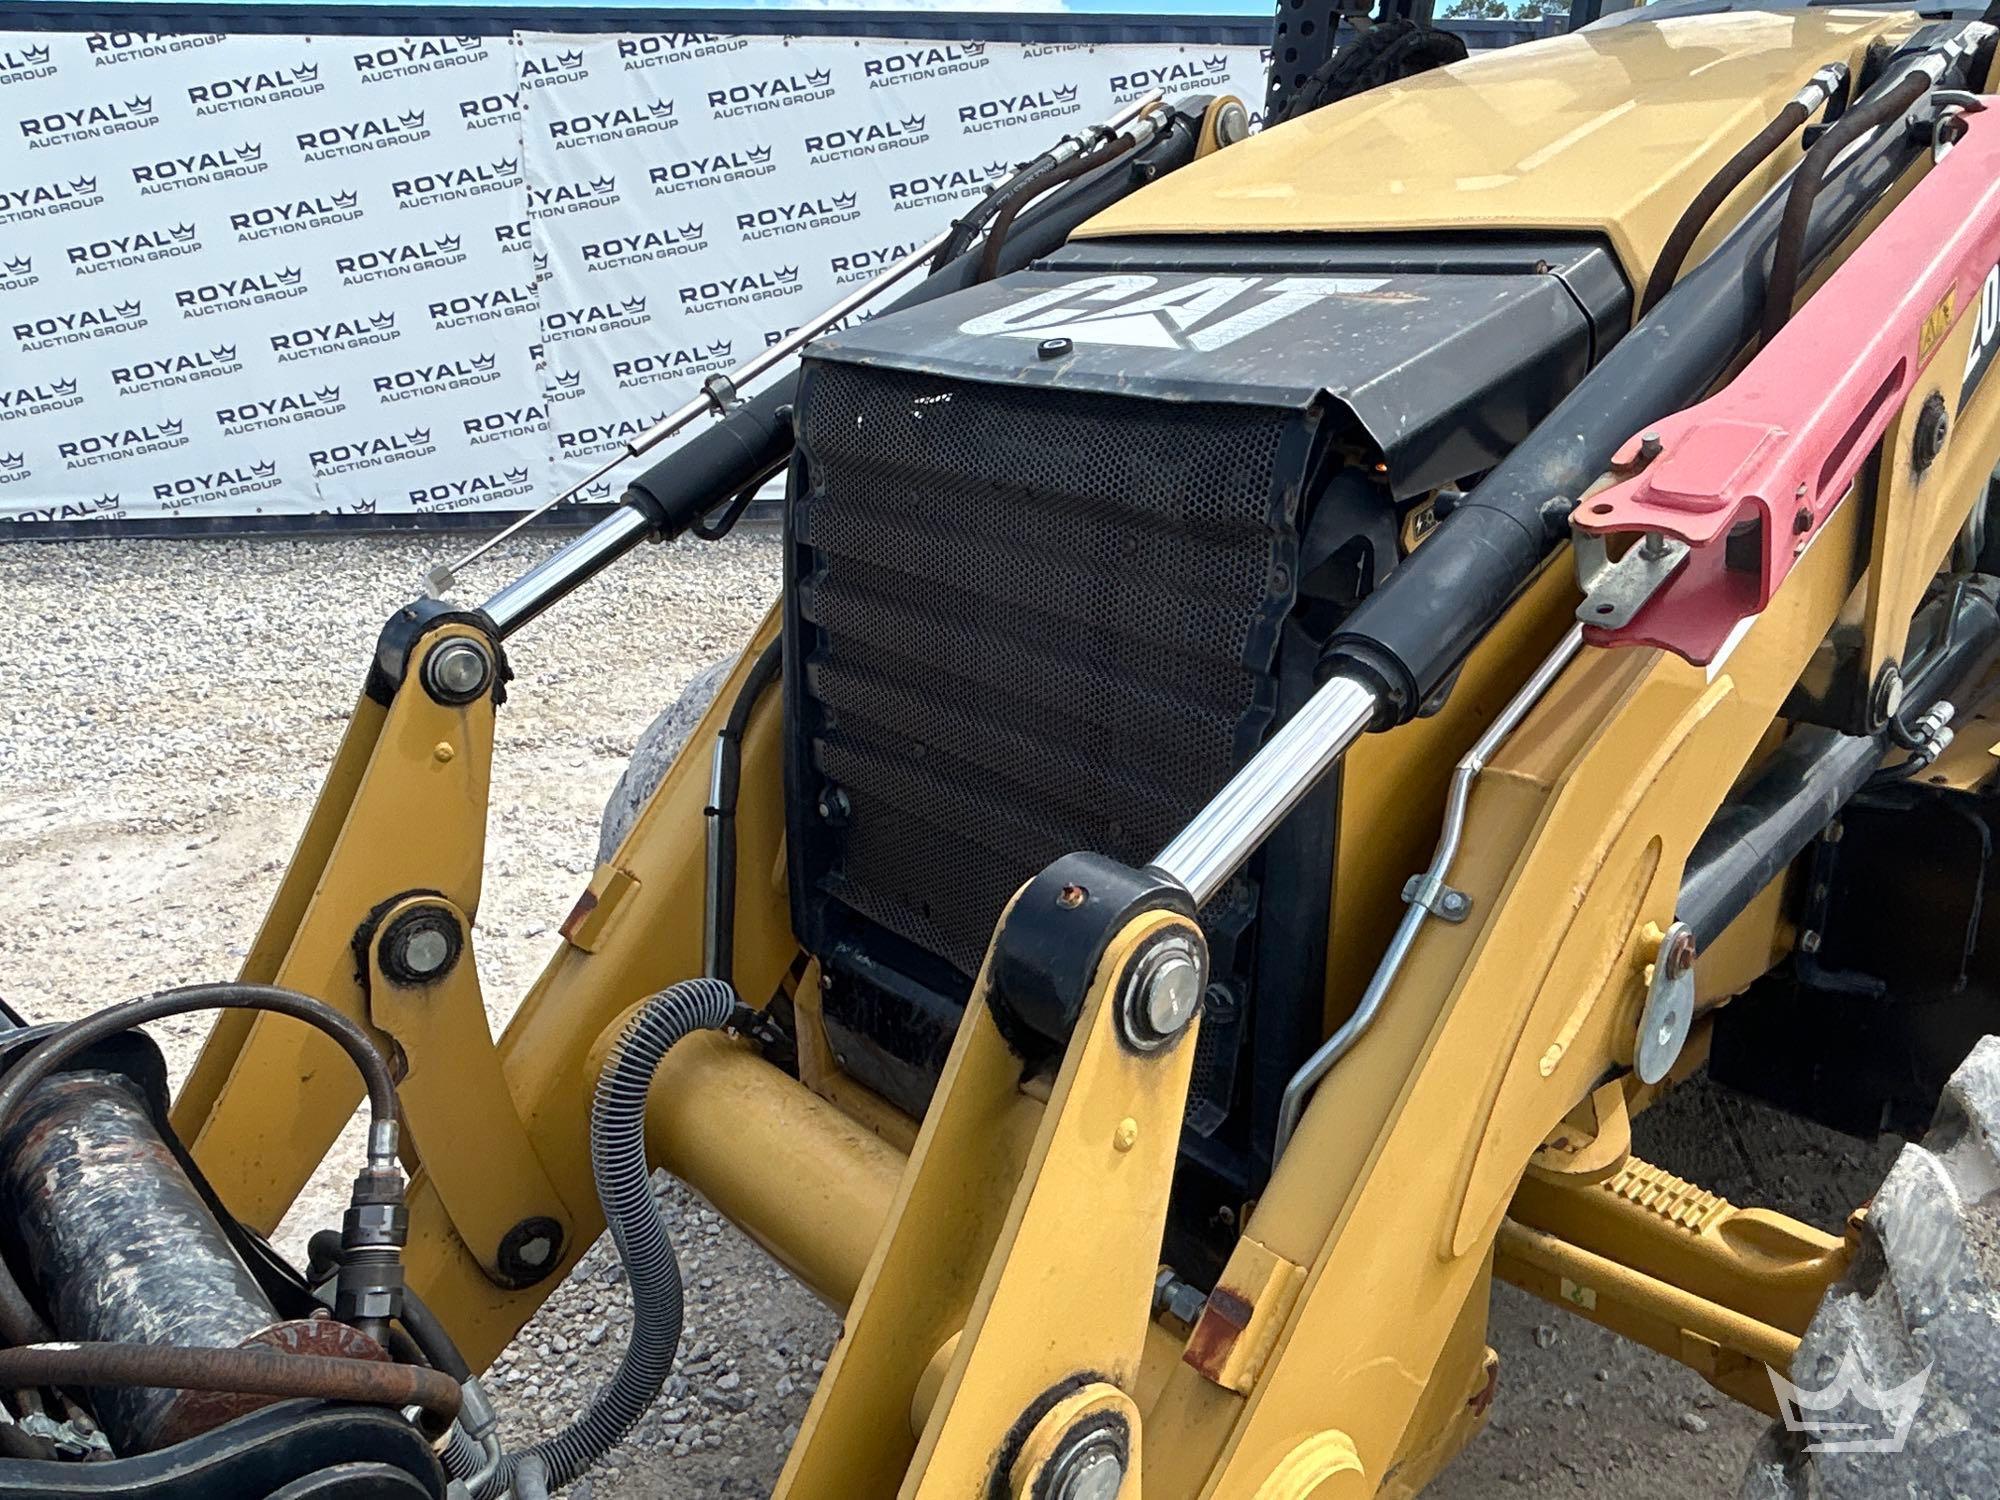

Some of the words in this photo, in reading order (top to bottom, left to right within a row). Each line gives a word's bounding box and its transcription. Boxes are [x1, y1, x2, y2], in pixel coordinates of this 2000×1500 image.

[96, 45, 167, 66] AUCTION
[170, 34, 226, 52] GROUP
[354, 38, 458, 71] ROYAL
[624, 50, 692, 71] AUCTION
[695, 40, 748, 57] GROUP
[864, 46, 962, 77] ROYAL
[0, 66, 57, 84] GROUP
[362, 62, 431, 84] AUCTION
[433, 51, 488, 69] GROUP
[534, 70, 588, 88] GROUP
[870, 69, 935, 89] AUCTION
[938, 58, 989, 76] GROUP
[1110, 62, 1204, 92] ROYAL
[1180, 74, 1230, 91] GROUP
[188, 71, 294, 104] ROYAL
[197, 95, 266, 116] AUCTION
[269, 83, 324, 102] GROUP
[708, 76, 806, 108] ROYAL
[459, 91, 519, 118] ROY
[714, 99, 780, 120] AUCTION
[782, 89, 835, 106] GROUP
[958, 92, 1054, 122] ROYAL
[963, 114, 1027, 134] AUCTION
[1030, 104, 1080, 121] GROUP
[20, 104, 128, 137] ROYAL
[30, 128, 100, 150] AUCTION
[103, 116, 159, 135] GROUP
[296, 118, 400, 150] ROYAL
[467, 112, 521, 130] AUCTIO
[549, 107, 650, 138] ROYAL
[556, 130, 623, 150] AUCTION
[626, 119, 678, 136] GROUP
[304, 142, 374, 163] AUCTION
[376, 130, 430, 148] GROUP
[805, 122, 902, 153] ROYAL
[810, 145, 875, 165] AUCTION
[878, 134, 929, 151] GROUP
[132, 150, 237, 183] ROYAL
[141, 174, 210, 196] AUCTION
[212, 163, 268, 180] GROUP
[392, 166, 494, 198] ROYAL
[649, 152, 748, 184] ROYAL
[656, 175, 721, 196] AUCTION
[724, 165, 776, 182] GROUP
[400, 189, 467, 210] AUCTION
[470, 178, 523, 195] GROUP
[890, 169, 984, 200] ROYAL
[48, 196, 104, 214] GROUP
[230, 198, 334, 230] ROYAL
[568, 195, 620, 212] GROUP
[736, 200, 833, 230] ROYAL
[894, 191, 958, 211] AUCTION
[238, 221, 307, 242] AUCTION
[309, 210, 363, 228] GROUP
[742, 222, 807, 242] AUCTION
[810, 211, 860, 228] GROUP
[66, 231, 172, 264] ROYAL
[76, 254, 145, 276] AUCTION
[147, 242, 202, 261] GROUP
[336, 242, 437, 274] ROYAL
[582, 230, 680, 260] ROYAL
[588, 252, 654, 272] AUCTION
[656, 242, 708, 258] GROUP
[344, 265, 410, 286] AUCTION
[413, 254, 466, 271] GROUP
[175, 275, 278, 307] ROYAL
[184, 298, 252, 319] AUCTION
[254, 286, 308, 304] GROUP
[428, 288, 528, 318] ROYAL
[679, 273, 775, 304] ROYAL
[685, 295, 749, 315] AUCTION
[752, 284, 802, 301] GROUP
[12, 308, 117, 340] ROYAL
[436, 310, 502, 330] AUCTION
[541, 326, 597, 343] UCTION
[600, 315, 651, 332] GROUP
[959, 276, 1392, 352] CAT
[22, 331, 91, 352] AUCTION
[93, 319, 148, 337] GROUP
[270, 320, 371, 351] ROYAL
[278, 342, 345, 363] AUCTION
[348, 330, 400, 348] GROUP
[112, 352, 213, 384] ROYAL
[373, 361, 472, 392] ROYAL
[613, 348, 708, 378] ROYAL
[619, 369, 683, 388] AUCTION
[686, 358, 736, 375] GROUP
[120, 375, 187, 396] AUCTION
[189, 364, 242, 381] GROUP
[381, 383, 446, 403] AUCTION
[448, 372, 500, 389] GROUP
[30, 396, 84, 414] GROUP
[216, 394, 316, 425] ROYAL
[224, 416, 290, 436] AUCTION
[293, 404, 346, 422] GROUP
[58, 427, 160, 458] ROYAL
[470, 425, 535, 446] AUCTION
[67, 449, 134, 470] AUCTION
[136, 437, 189, 454] GROUP
[309, 436, 408, 468] ROYAL
[314, 457, 382, 478] AUCTION
[384, 446, 436, 463] GROUP
[153, 468, 252, 500] ROYAL
[161, 490, 228, 511] AUCTION
[230, 478, 282, 496] GROUP
[409, 475, 506, 505] ROYAL
[482, 484, 533, 502] GROUP
